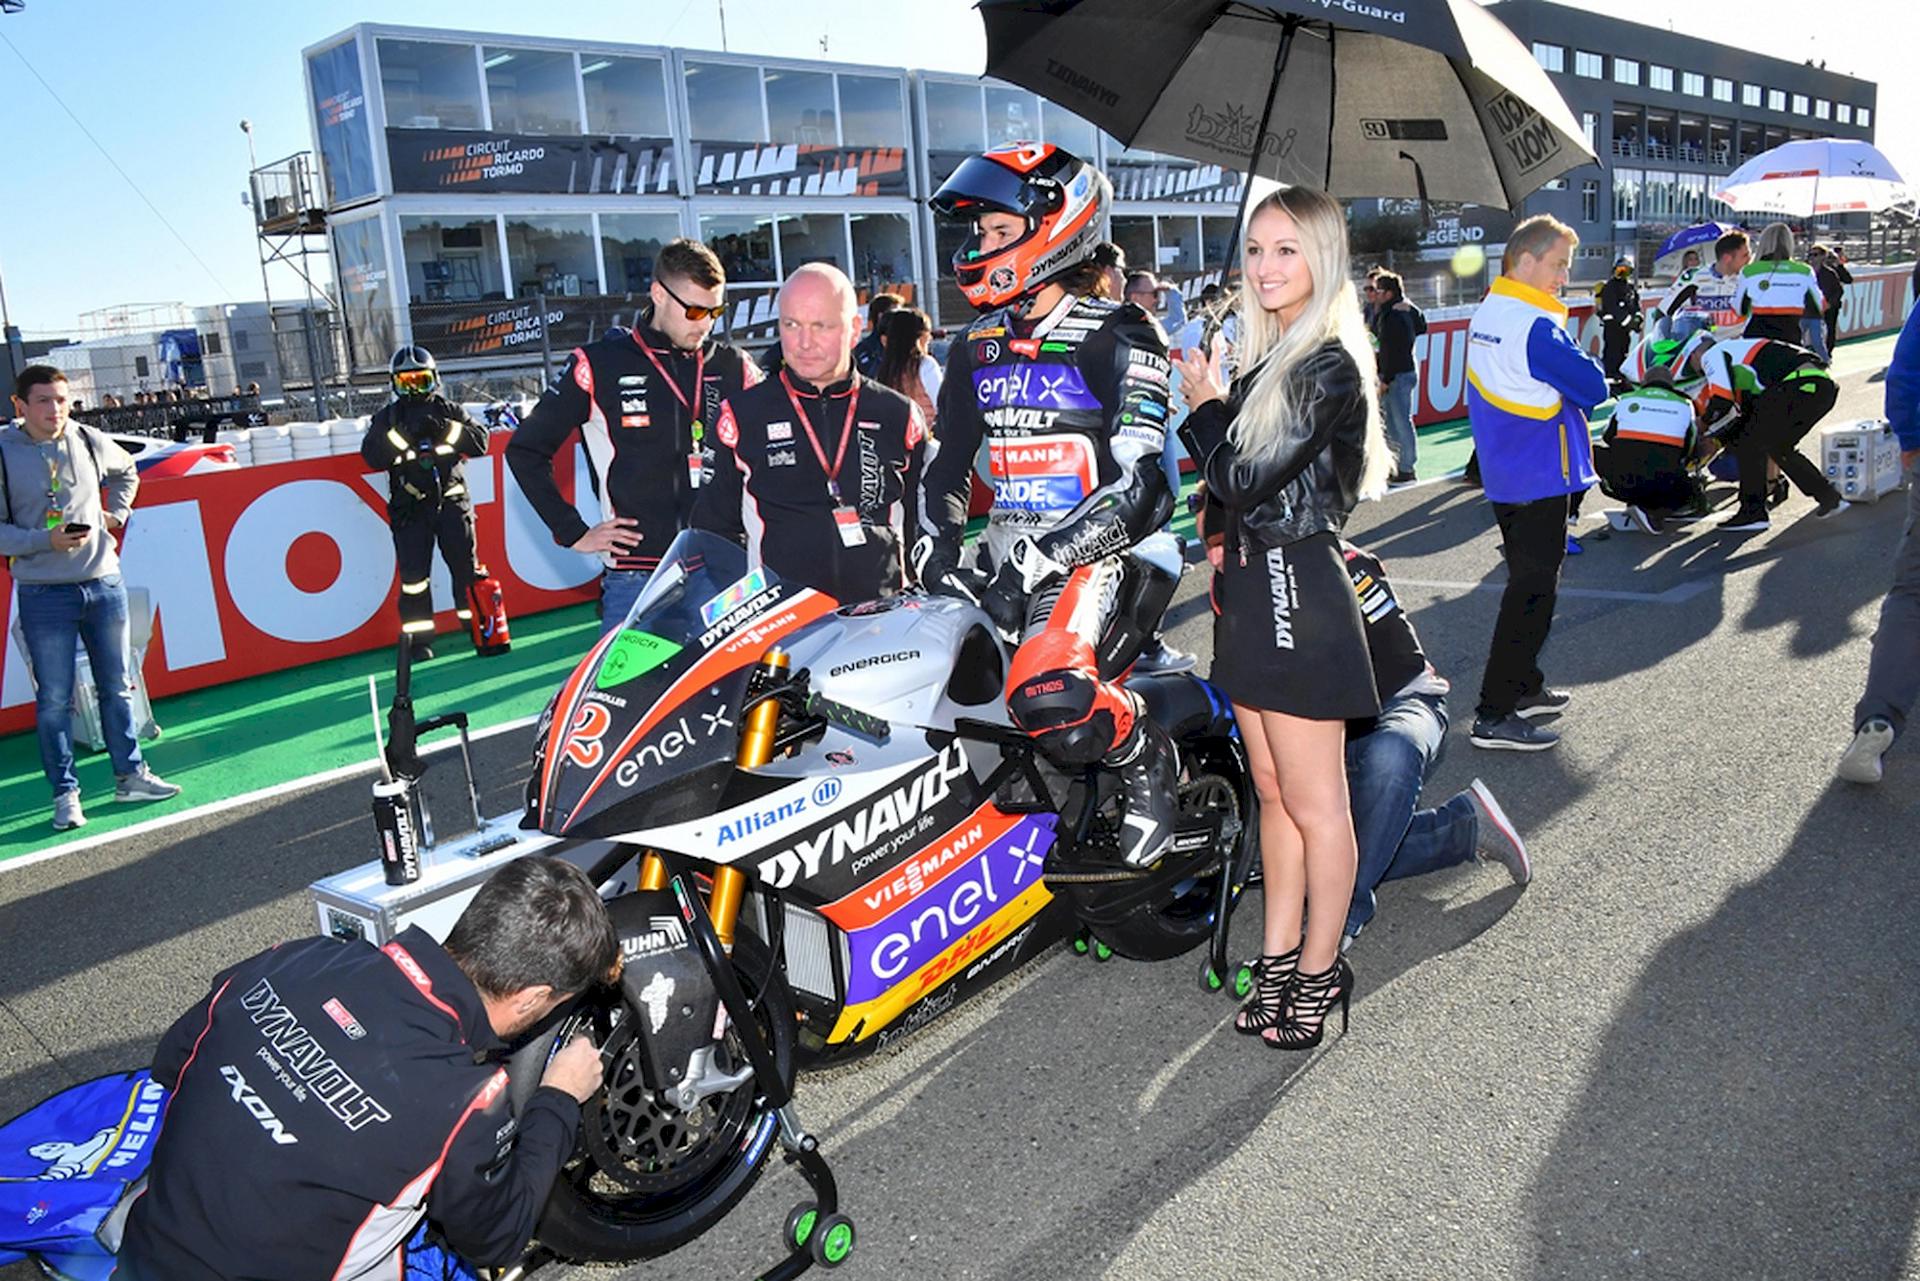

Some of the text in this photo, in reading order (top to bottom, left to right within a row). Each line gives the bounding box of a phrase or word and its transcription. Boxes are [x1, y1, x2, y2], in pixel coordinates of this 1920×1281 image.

[1321, 0, 1406, 23] y-Guard
[466, 139, 510, 156] CIRCUIT
[483, 163, 523, 179] TORMO
[494, 147, 545, 165] RICARDO
[1436, 219, 1459, 229] THE
[1030, 232, 1084, 278] DYNAVOLT
[487, 306, 530, 325] CIRCUIT
[514, 310, 564, 331] RICADO
[1838, 280, 1884, 333] OTUL
[978, 368, 1031, 404] enel
[1121, 428, 1155, 443] Allianz
[699, 585, 782, 648] DYNAVOLT
[1025, 679, 1065, 698] MITHOS
[616, 704, 734, 787] enel X
[395, 806, 418, 879] DYNAVOLT
[717, 797, 807, 847] Allianz
[851, 814, 935, 876] power your life
[864, 824, 983, 910] VIESSMANN
[870, 827, 1044, 979] enel X
[620, 931, 667, 955] UHN
[920, 924, 997, 991] DHL
[240, 977, 392, 1131] DYNAVOLT
[256, 1046, 308, 1103] power your life
[106, 1077, 165, 1168] HELIN
